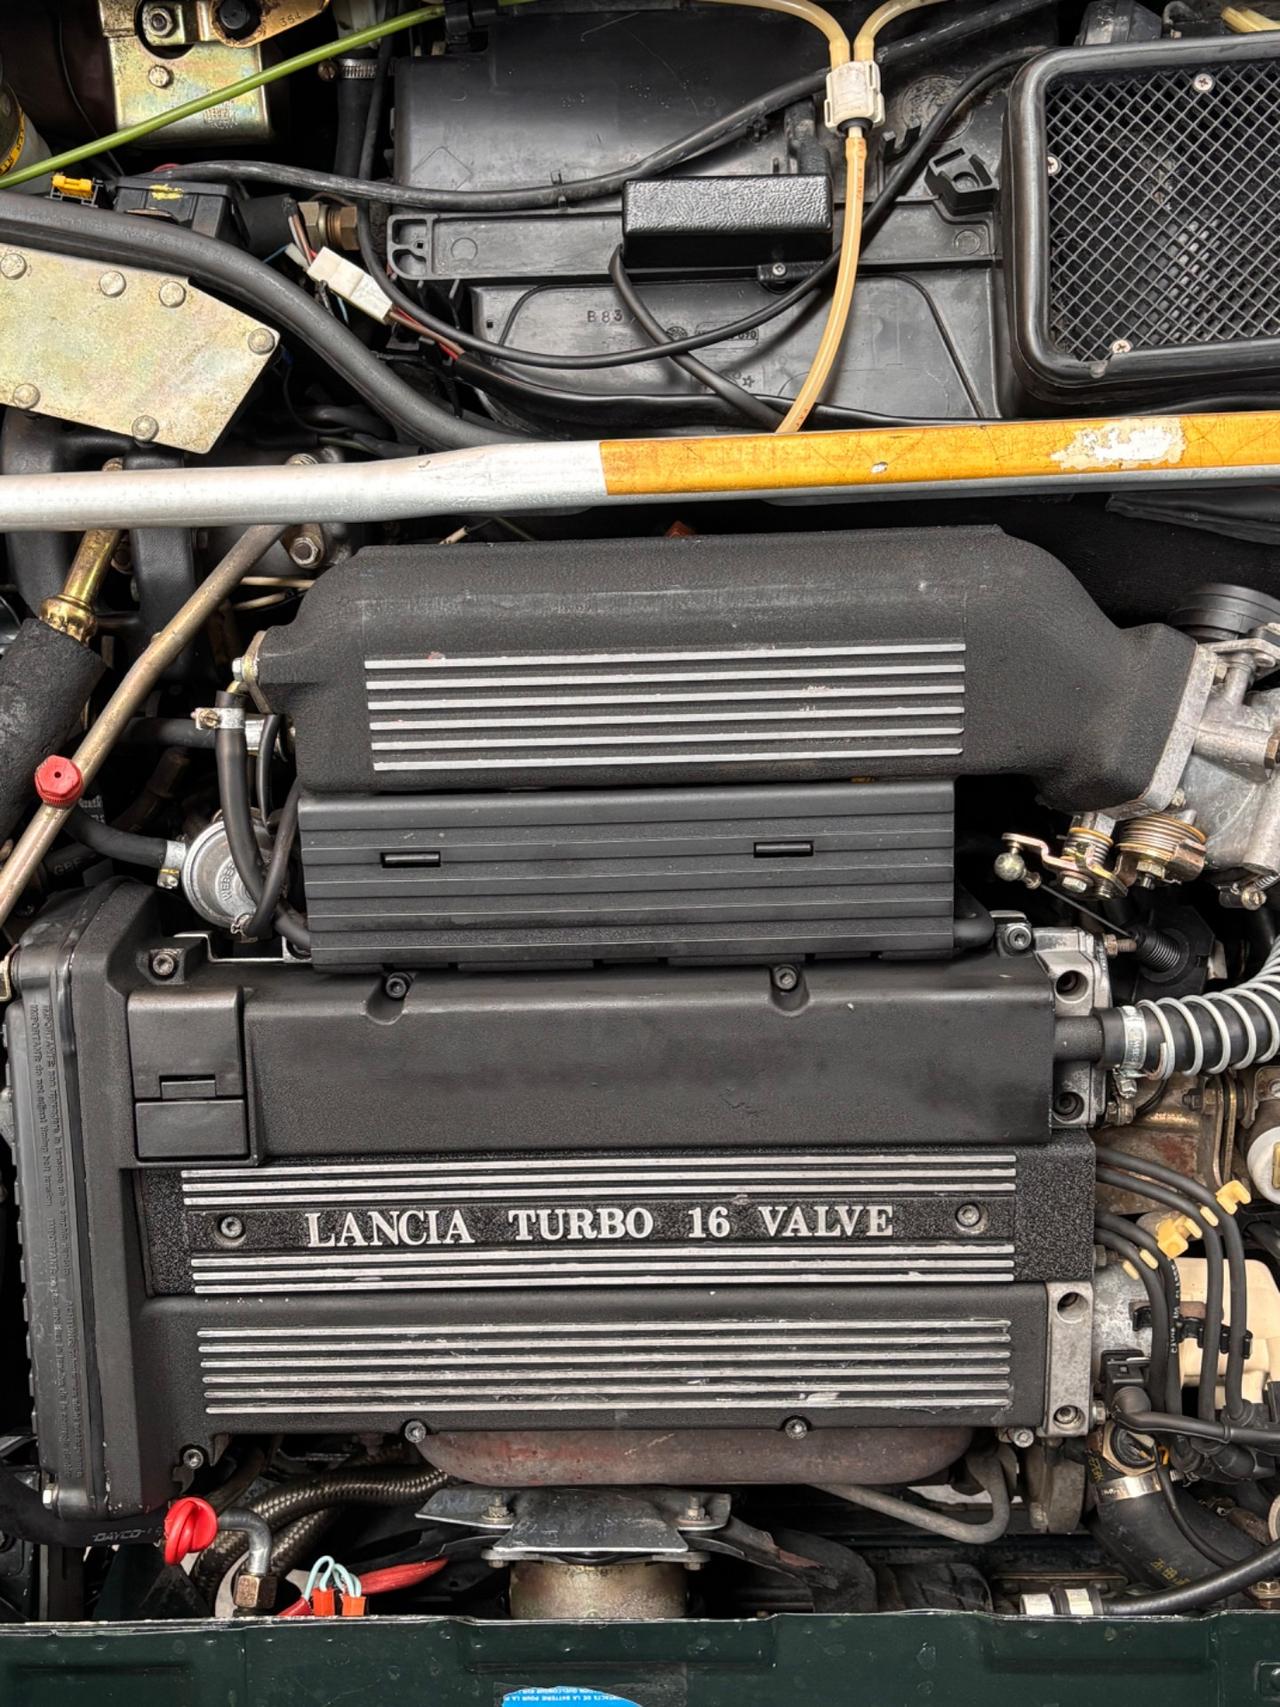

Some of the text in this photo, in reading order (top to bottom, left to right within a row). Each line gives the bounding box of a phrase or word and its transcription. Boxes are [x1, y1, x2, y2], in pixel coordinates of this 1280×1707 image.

[306, 1204, 895, 1247] LANCIA TURBO 16 VALVE
